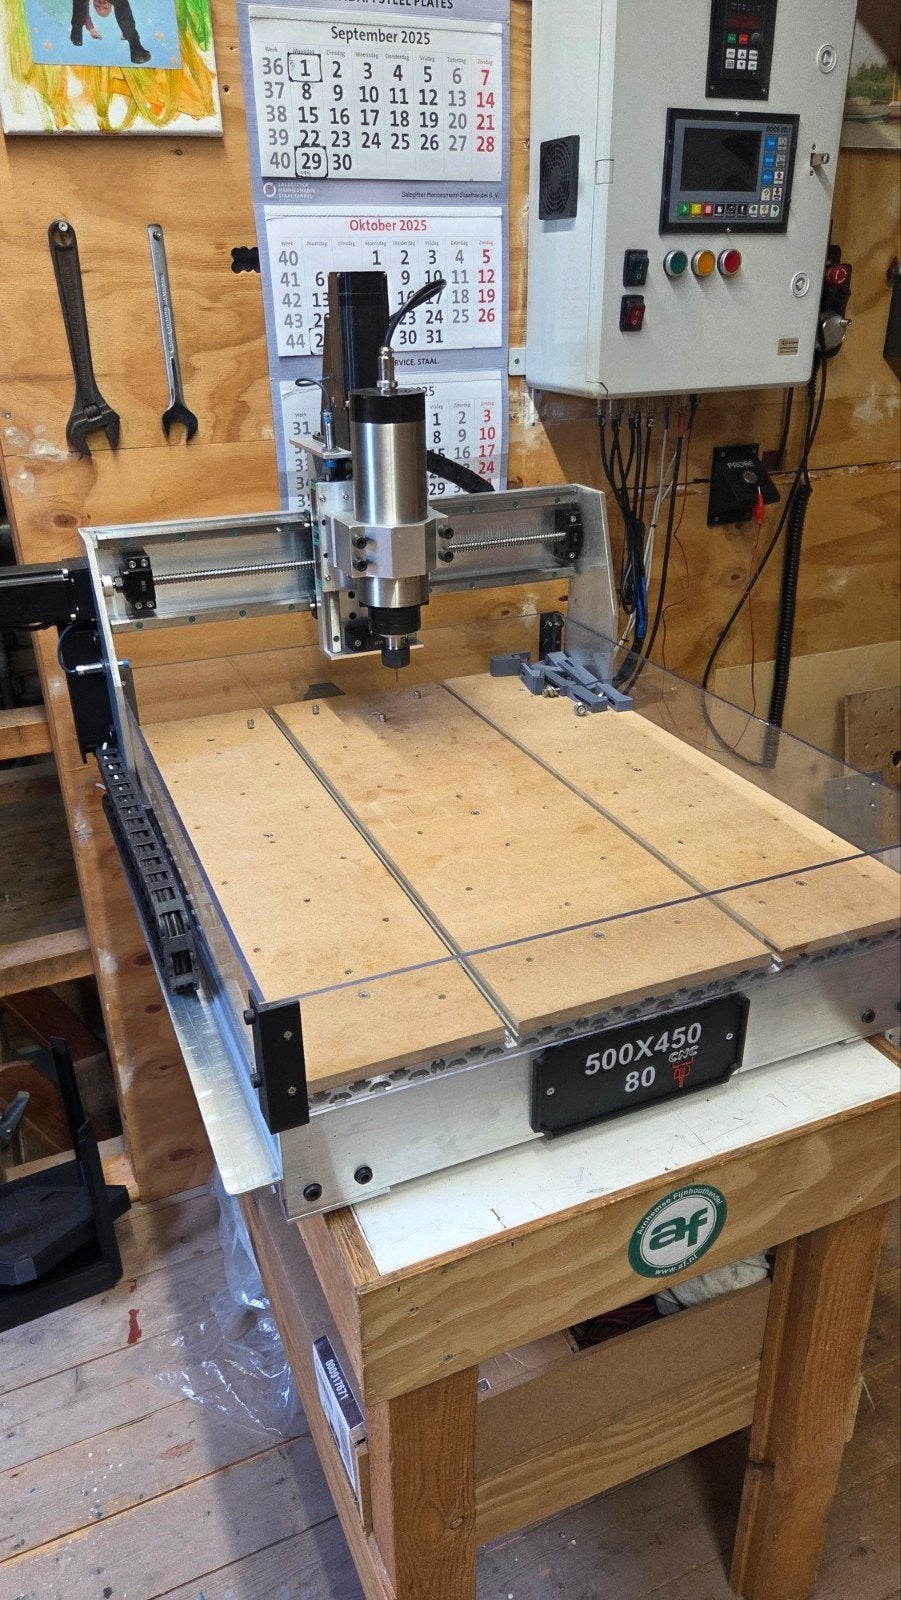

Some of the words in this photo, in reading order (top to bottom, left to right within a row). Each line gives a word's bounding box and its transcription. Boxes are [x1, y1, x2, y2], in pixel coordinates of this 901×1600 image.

[414, 0, 454, 9] PLATES
[331, 26, 398, 44] September
[401, 30, 431, 45] 2025
[262, 57, 284, 76] 36
[300, 59, 311, 77] 1
[332, 60, 343, 79] 2
[363, 62, 373, 80] 3
[392, 64, 403, 82] 4
[423, 65, 433, 83] 5
[452, 67, 462, 84] 6
[480, 69, 490, 86] 7
[264, 81, 285, 99] 37
[301, 82, 312, 100] 8
[333, 84, 343, 102] 9
[359, 85, 379, 103] 10
[389, 87, 409, 105] 11
[419, 89, 438, 106] 12
[448, 90, 467, 107] 13
[476, 91, 495, 109] 14
[266, 104, 287, 123] 38
[297, 106, 318, 124] 15
[330, 107, 350, 125] 16
[360, 108, 380, 127] 17
[390, 110, 410, 128] 18
[419, 111, 439, 128] 19
[448, 112, 467, 130] 20
[476, 113, 495, 131] 21
[268, 128, 289, 146] 39
[300, 129, 320, 148] 22
[331, 130, 351, 148] 23
[361, 131, 381, 149] 24
[391, 132, 410, 150] 25
[420, 133, 439, 151] 26
[448, 134, 467, 152] 27
[476, 135, 495, 152] 28
[269, 151, 291, 169] 40
[301, 152, 322, 170] 29
[332, 153, 352, 171] 30
[349, 219, 397, 231] Oktober
[399, 219, 427, 231] 2025
[278, 251, 299, 267] 40
[372, 250, 381, 265] 1
[401, 250, 409, 265] 2
[428, 249, 437, 264] 3
[455, 249, 464, 264] 4
[482, 249, 491, 264] 5
[280, 272, 300, 287] 41
[315, 271, 325, 287] 6
[401, 270, 410, 285] 9
[424, 270, 443, 285] 10
[452, 269, 469, 284] 11
[478, 269, 495, 284] 12
[282, 293, 302, 308] 42
[312, 292, 329, 308] 13
[452, 289, 469, 304] 18
[478, 289, 495, 304] 19
[284, 313, 303, 329] 43
[398, 310, 416, 325] 23
[425, 309, 443, 325] 24
[452, 309, 469, 324] 25
[478, 308, 495, 323] 26
[286, 334, 306, 349] 44
[315, 333, 324, 348] 2
[399, 330, 417, 345] 30
[426, 329, 444, 344] 31
[417, 358, 440, 366] STAAL.
[292, 421, 312, 436] 31
[433, 412, 441, 426] 1
[458, 411, 466, 424] 2
[483, 409, 491, 423] 3
[433, 430, 442, 444] 8
[458, 429, 467, 442] 9
[479, 426, 496, 441] 10
[454, 446, 471, 460] 16
[478, 444, 495, 458] 17
[295, 458, 308, 473] 3
[478, 461, 495, 475] 24
[727, 460, 755, 469] PROBE
[296, 476, 309, 491] 3
[429, 482, 446, 496] 29
[585, 1022, 702, 1075] 500X450
[624, 1065, 656, 1093] 80
[668, 1045, 699, 1063] CNC
[637, 1198, 671, 1235] Arnhemse
[672, 1188, 723, 1205] Fijnhouthandel
[649, 1207, 708, 1251] af
[655, 1253, 698, 1275] www.af.nl
[325, 1358, 349, 1400] 000917671
